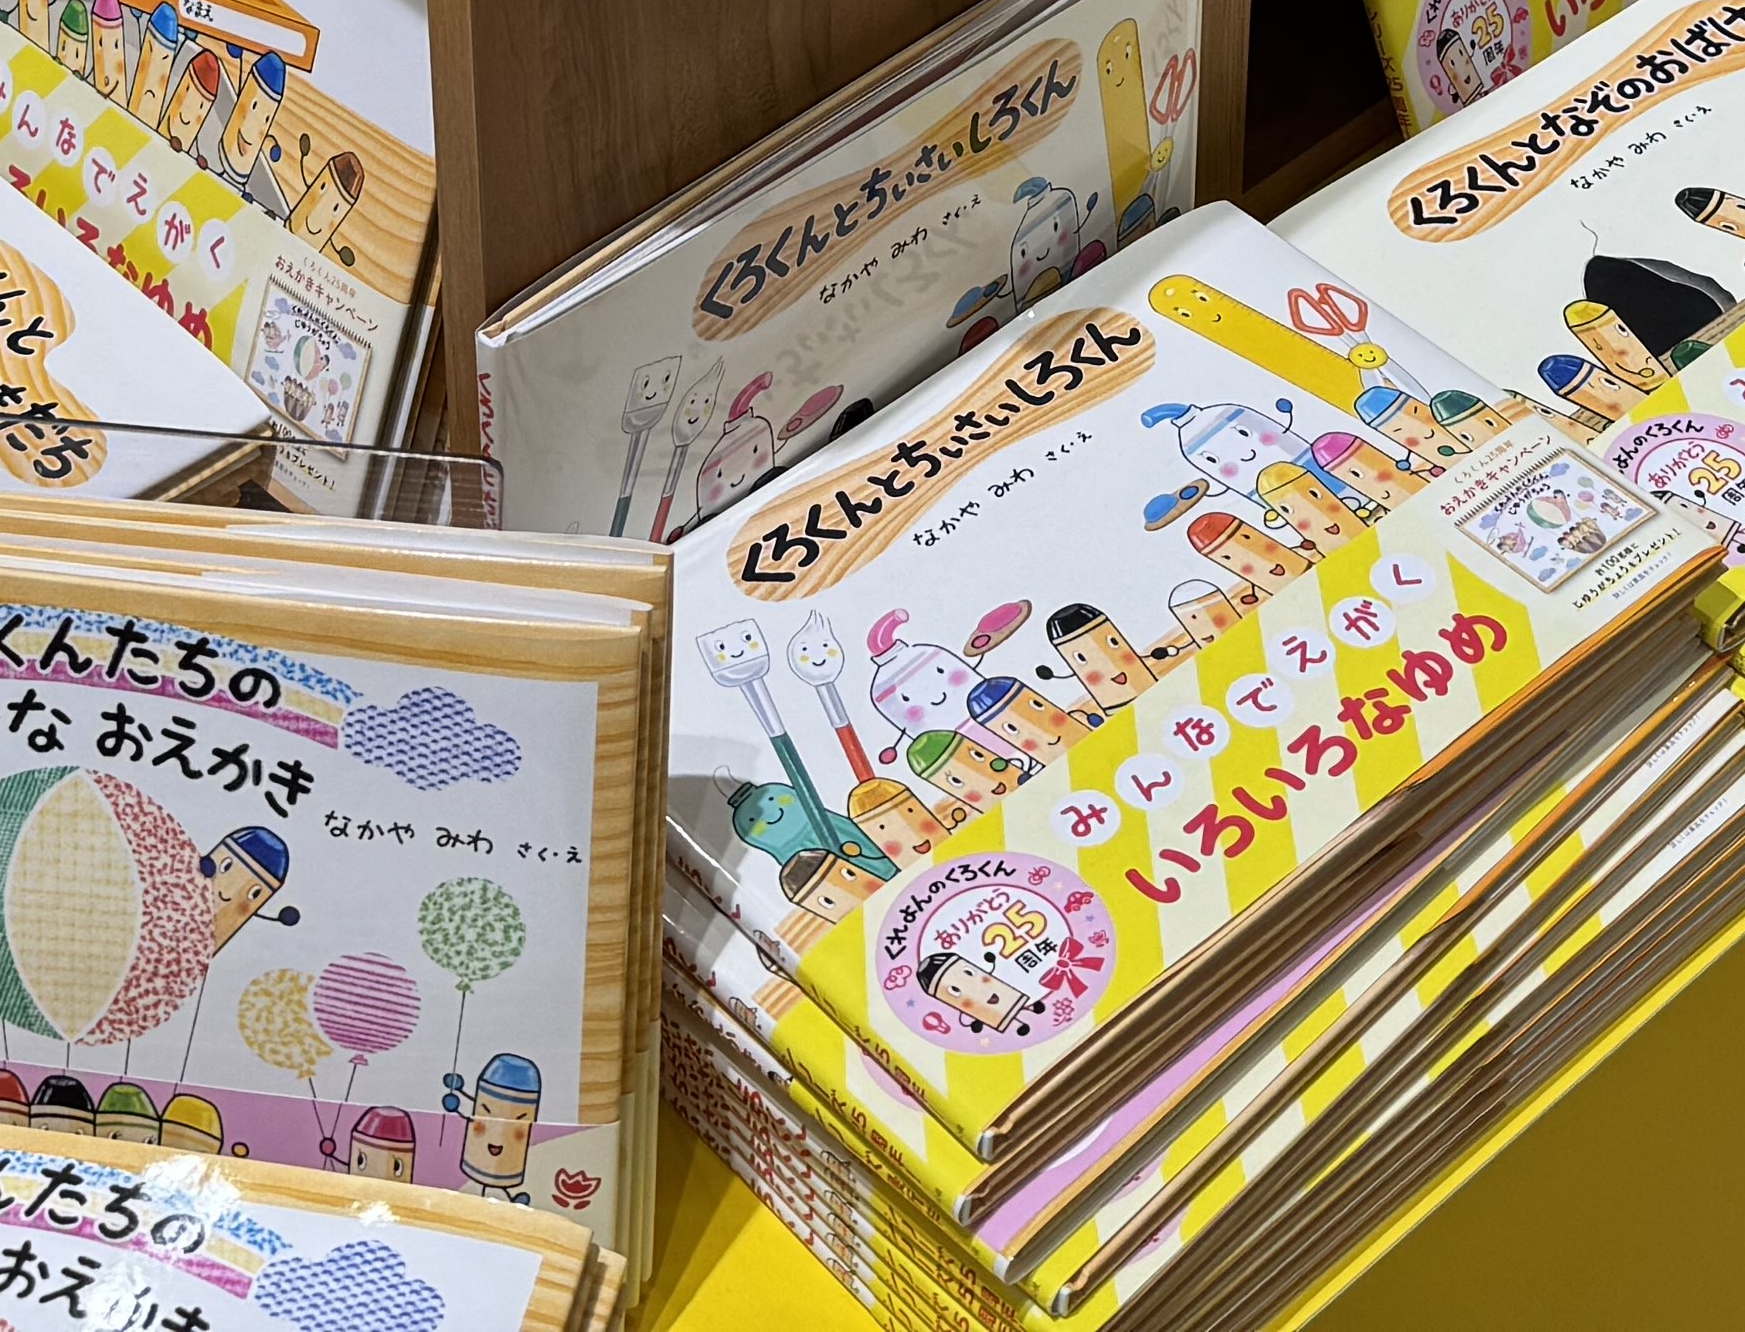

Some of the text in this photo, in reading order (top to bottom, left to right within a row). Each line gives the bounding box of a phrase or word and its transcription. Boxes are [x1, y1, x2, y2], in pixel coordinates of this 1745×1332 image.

[699, 59, 1081, 321] くろくんとちいさいしろくん
[275, 254, 379, 332] おえかきキャンペーン
[741, 317, 1141, 588] くろくんとちいさいしろくん
[1440, 435, 1552, 516] おえかきキャンペーン
[1648, 441, 1707, 490] ありがとう
[1694, 449, 1743, 498] 25
[911, 496, 977, 549] なかや
[986, 466, 1036, 507] みわ
[1064, 562, 1427, 840] みんなでえがく
[94, 704, 316, 819] おえかき
[1124, 614, 1508, 905] いろいろなゆめ
[322, 812, 416, 845] なかや
[434, 826, 494, 857] みわ
[883, 858, 1018, 961] くれよんのくろくん
[931, 887, 1012, 954] ありがとう
[980, 898, 1050, 961] 25
[1015, 936, 1062, 974] 周年
